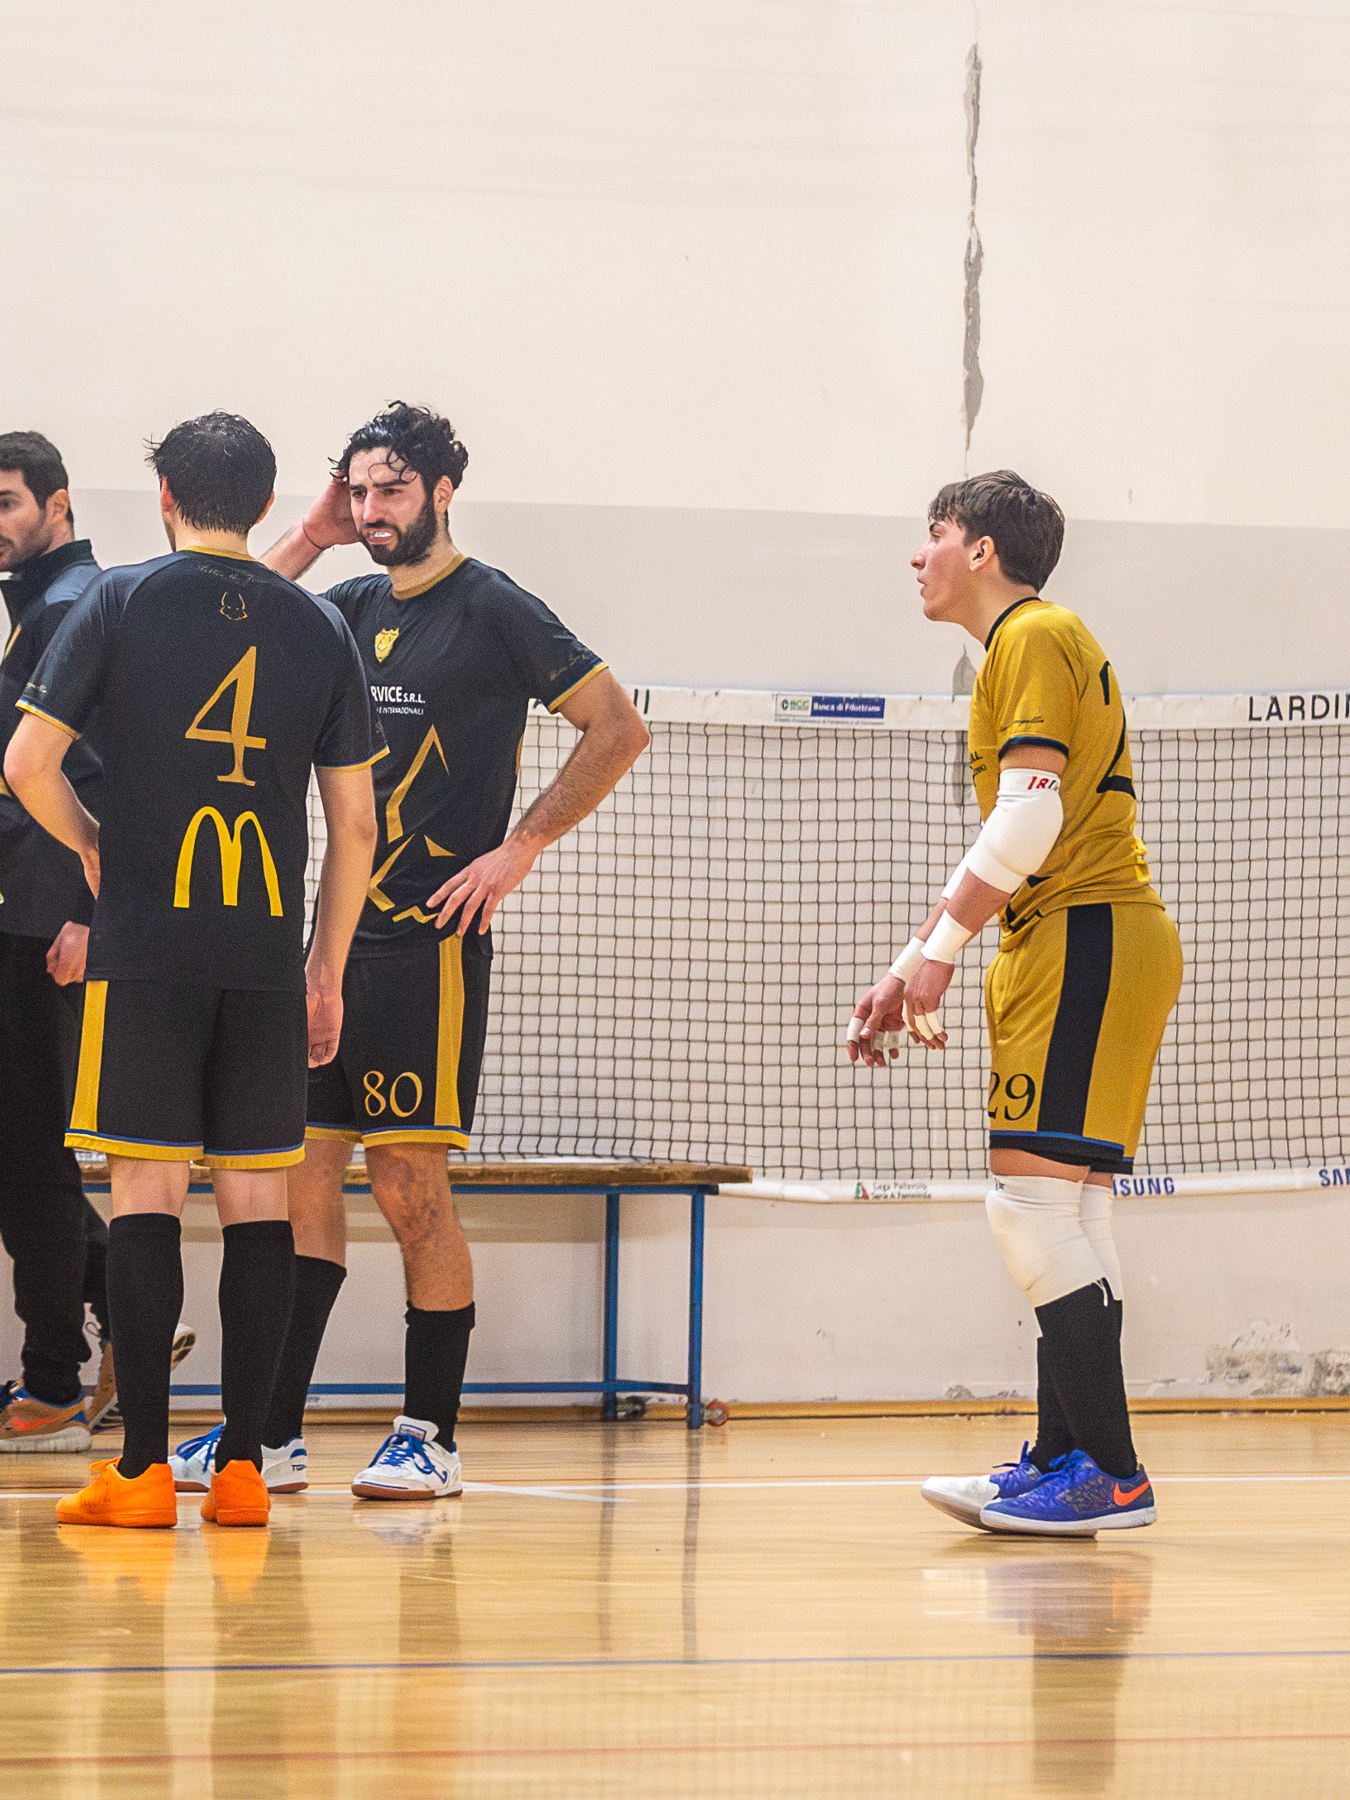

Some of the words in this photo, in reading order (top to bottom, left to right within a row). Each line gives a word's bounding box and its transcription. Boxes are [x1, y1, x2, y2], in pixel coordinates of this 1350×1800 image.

[185, 645, 267, 787] 4
[362, 1070, 423, 1118] 80
[988, 1071, 1036, 1121] 29
